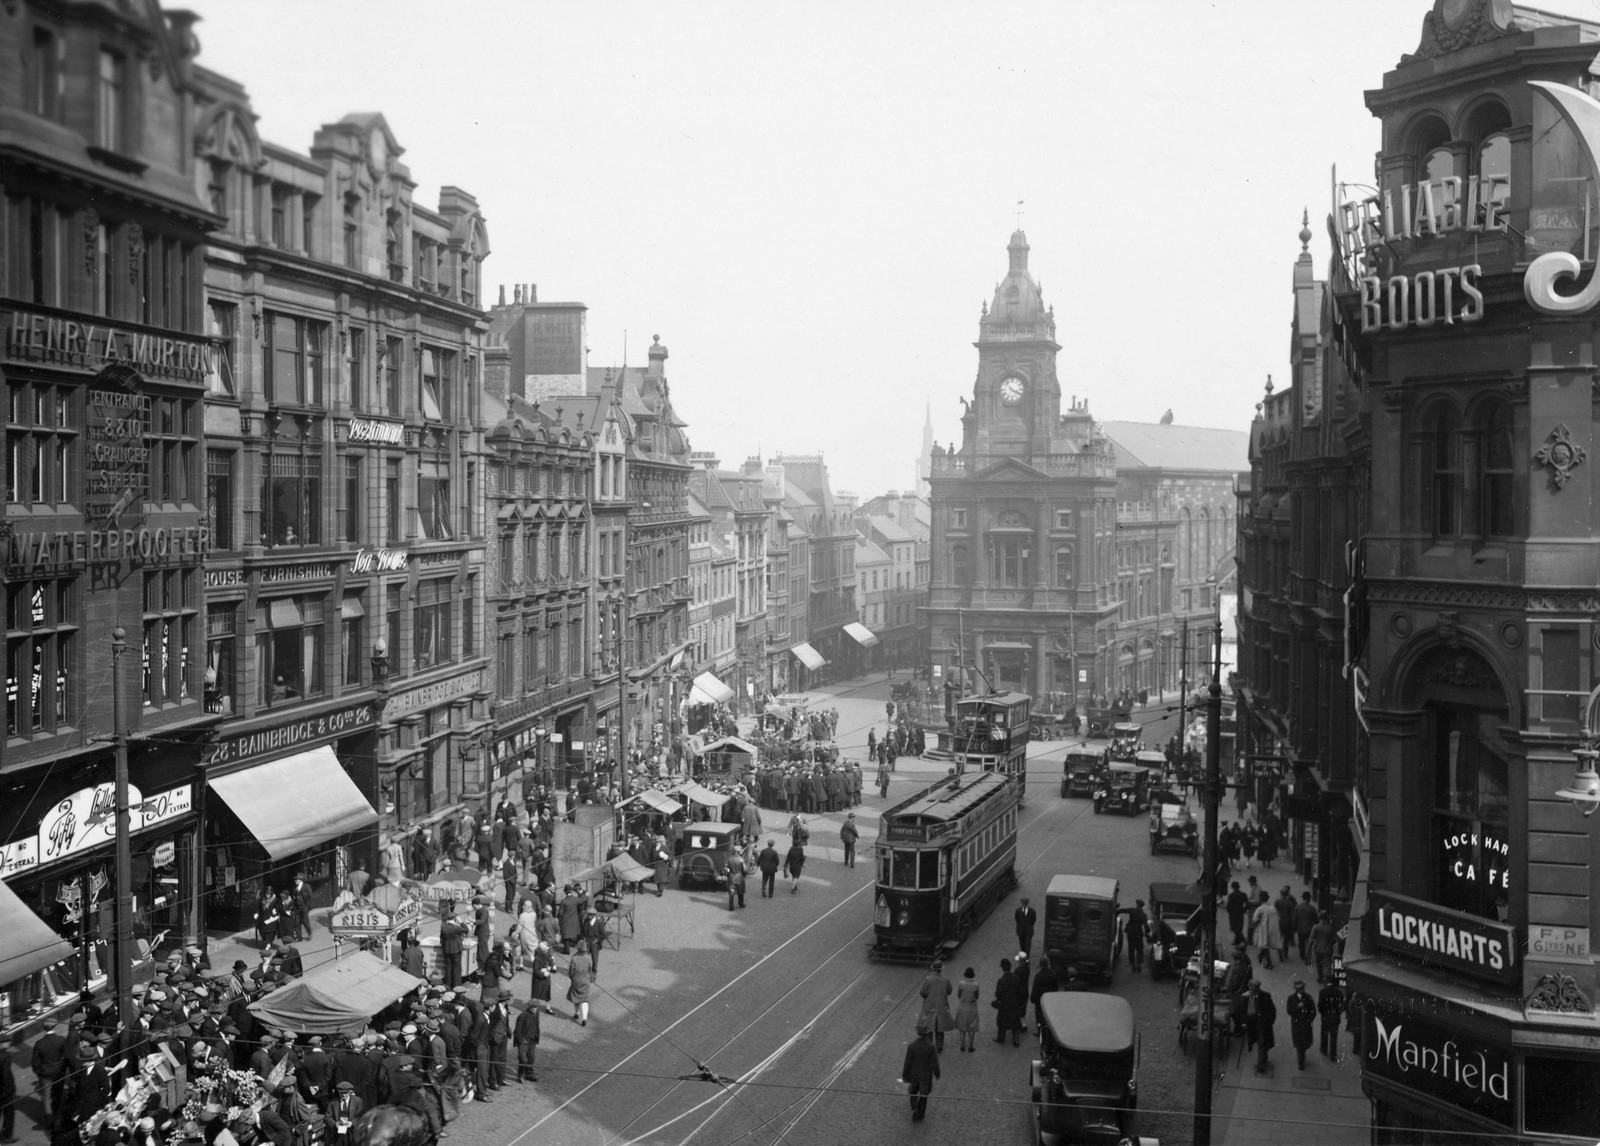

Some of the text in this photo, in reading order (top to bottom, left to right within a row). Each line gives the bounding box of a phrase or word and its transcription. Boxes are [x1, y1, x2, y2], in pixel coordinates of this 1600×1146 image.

[1338, 173, 1511, 260] RELIABLE
[1360, 263, 1484, 335] BOOTS
[13, 311, 95, 356] HENRY
[132, 331, 214, 375] MURTON
[545, 322, 573, 334] WHITE
[94, 390, 149, 411] ENTRANCE
[95, 442, 148, 463] GRAINGER
[100, 469, 144, 488] STREET
[13, 526, 211, 567] WATERPROOFER
[204, 570, 244, 587] HOUSE
[259, 564, 332, 583] FURNISHING
[239, 722, 315, 757] BAINBRIDGE
[318, 718, 326, 735] &
[356, 706, 370, 725] 26
[169, 802, 190, 814] EXTRAS
[9, 856, 35, 871] EXTRAS
[341, 912, 380, 926] RISI'S
[1378, 907, 1504, 971] LOCKHARTS
[1201, 986, 1209, 1036] STOP
[1369, 1015, 1508, 1101] Manfield
